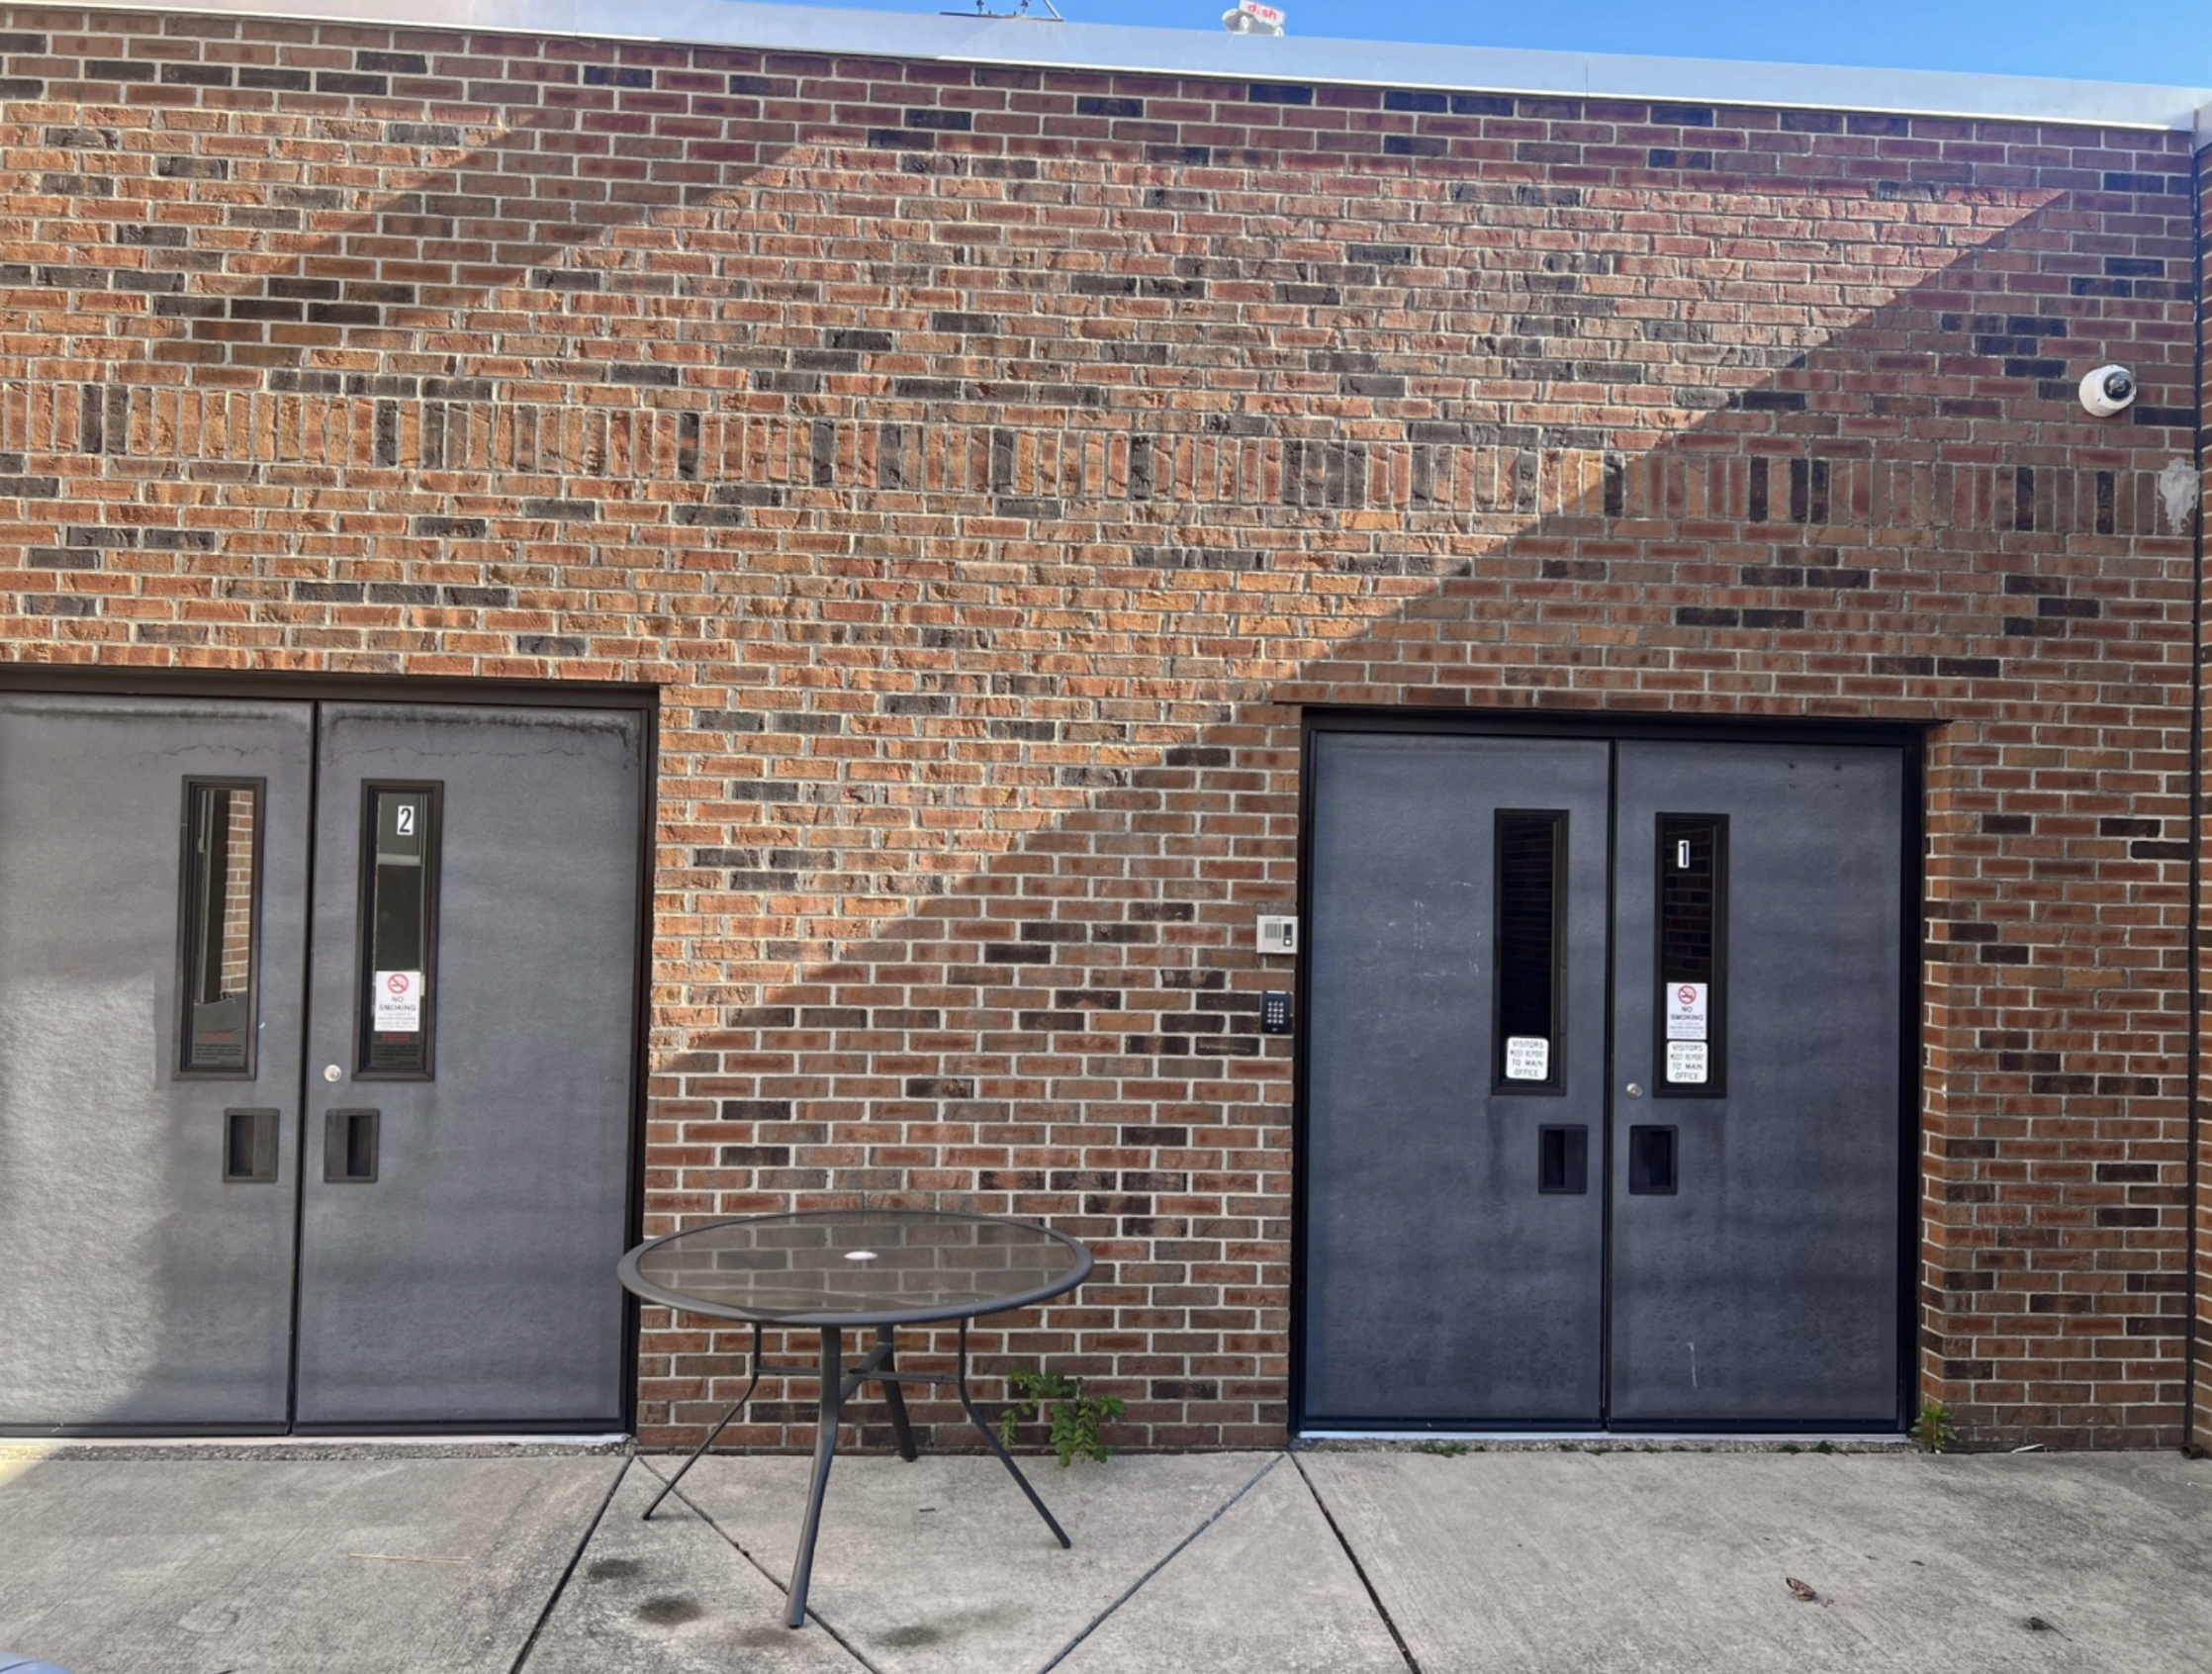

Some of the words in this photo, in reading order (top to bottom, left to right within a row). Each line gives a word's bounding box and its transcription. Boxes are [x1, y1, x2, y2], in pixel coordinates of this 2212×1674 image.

[1247, 3, 1277, 20] dish
[400, 807, 412, 833] 2
[1681, 842, 1687, 866] 1
[1513, 1040, 1544, 1049] VISITORS
[1514, 1069, 1539, 1077] OFFICE
[1675, 1071, 1699, 1080] OFFICE
